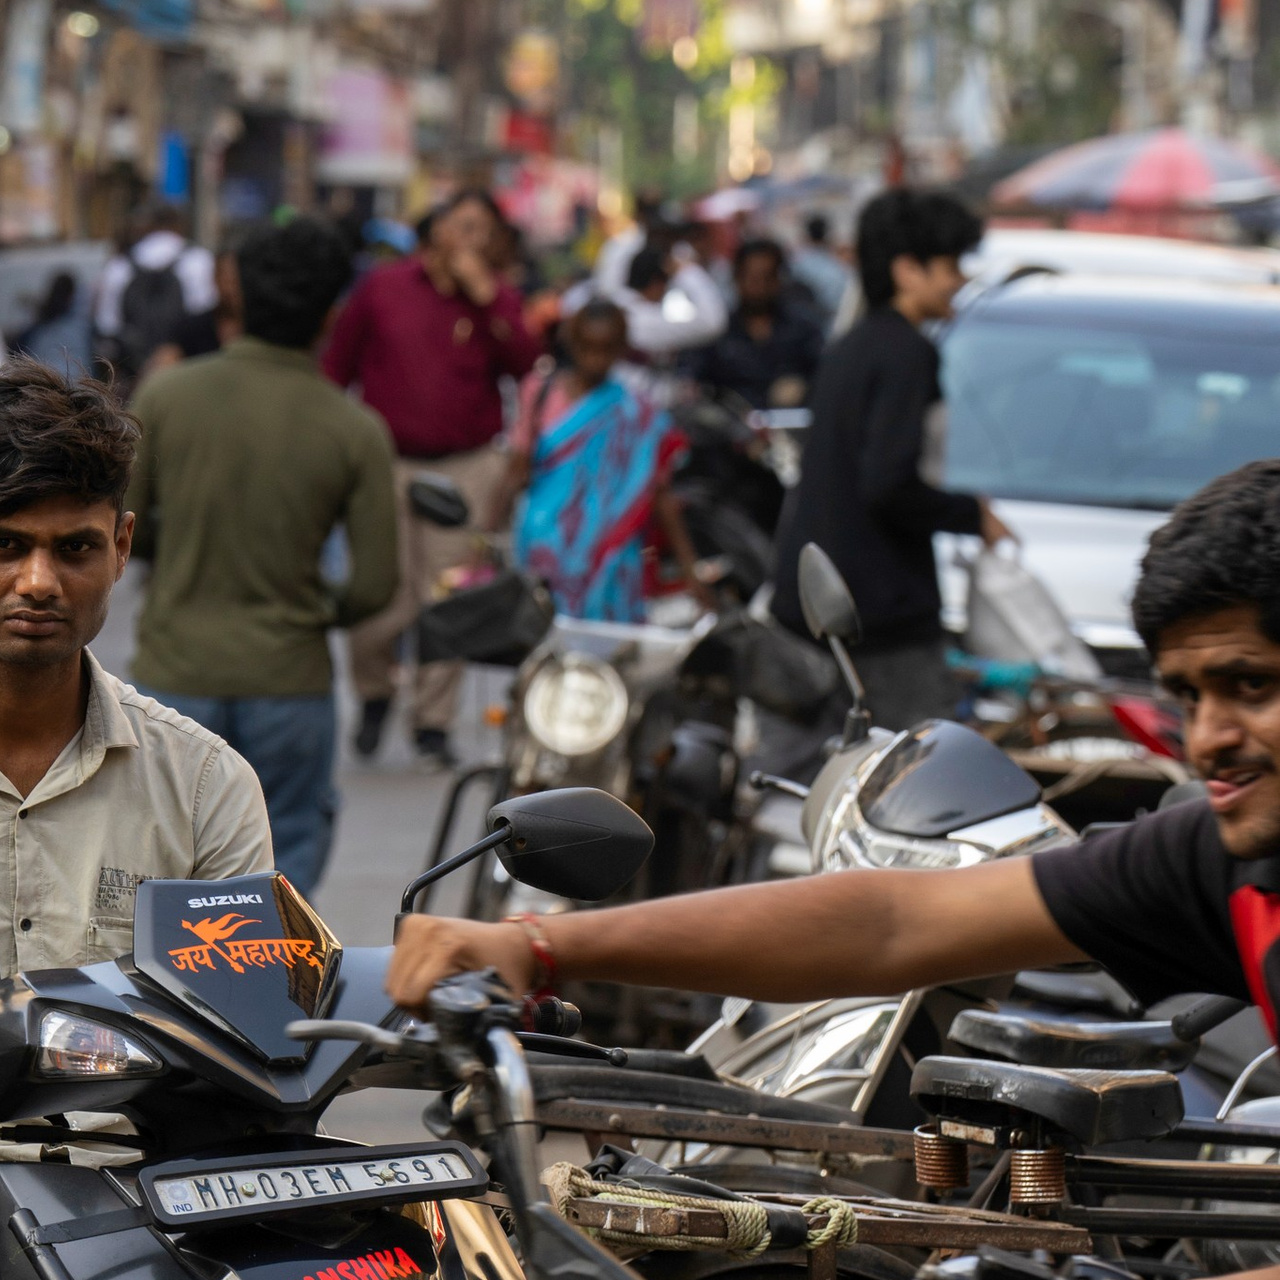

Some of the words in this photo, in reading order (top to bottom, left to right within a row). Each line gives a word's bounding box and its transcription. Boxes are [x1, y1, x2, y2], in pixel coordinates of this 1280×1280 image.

[187, 894, 263, 909] SUZUKI
[168, 944, 217, 973] जय
[223, 938, 324, 969] महाराष्ट्र
[172, 1202, 193, 1214] IND
